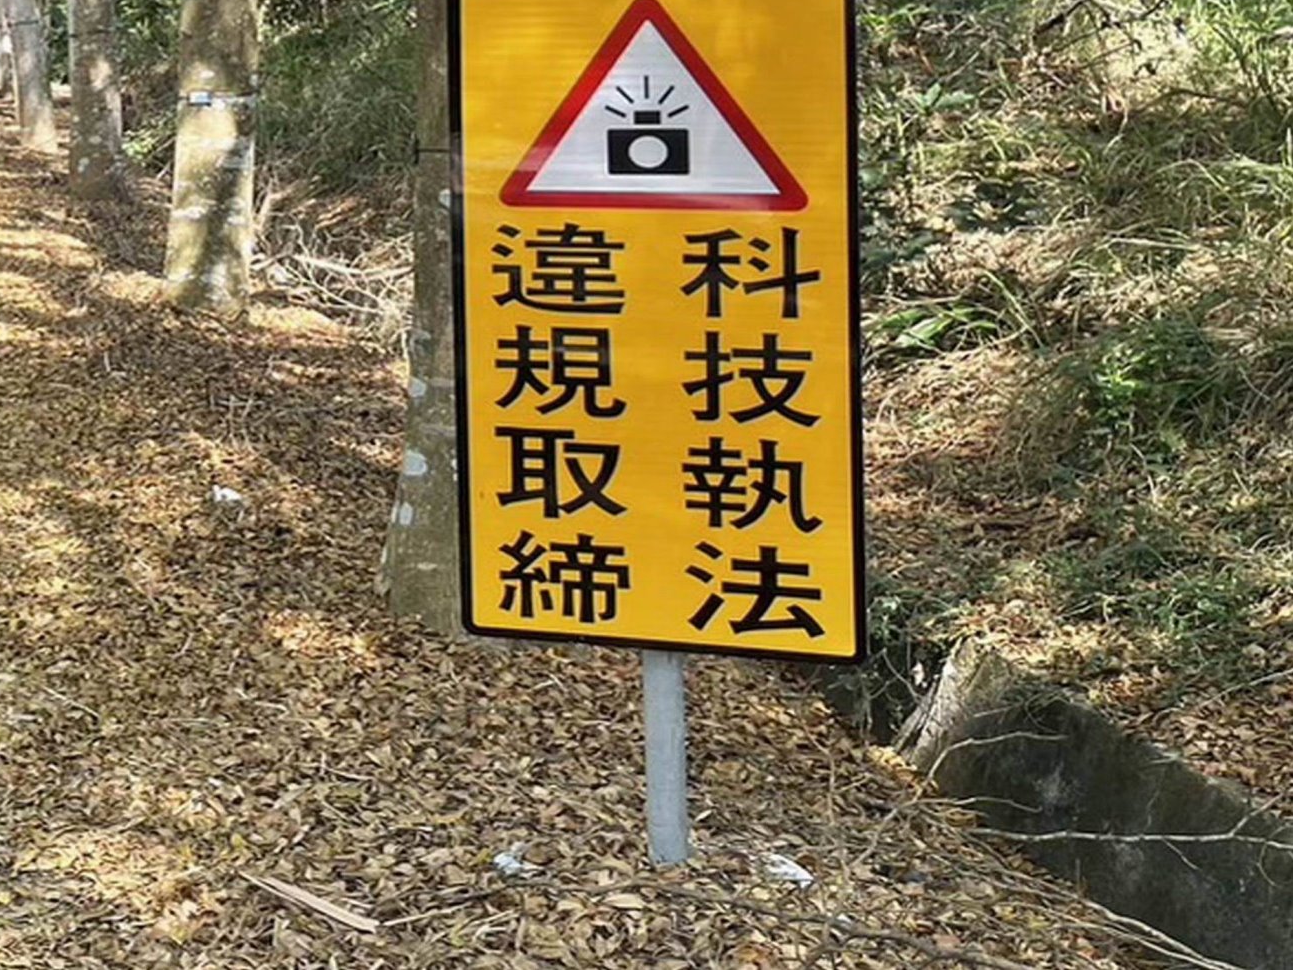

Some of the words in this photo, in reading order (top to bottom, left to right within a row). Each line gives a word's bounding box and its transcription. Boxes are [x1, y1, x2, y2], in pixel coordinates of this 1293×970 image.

[491, 223, 630, 624] 違規取締
[681, 226, 824, 638] 科技執法
